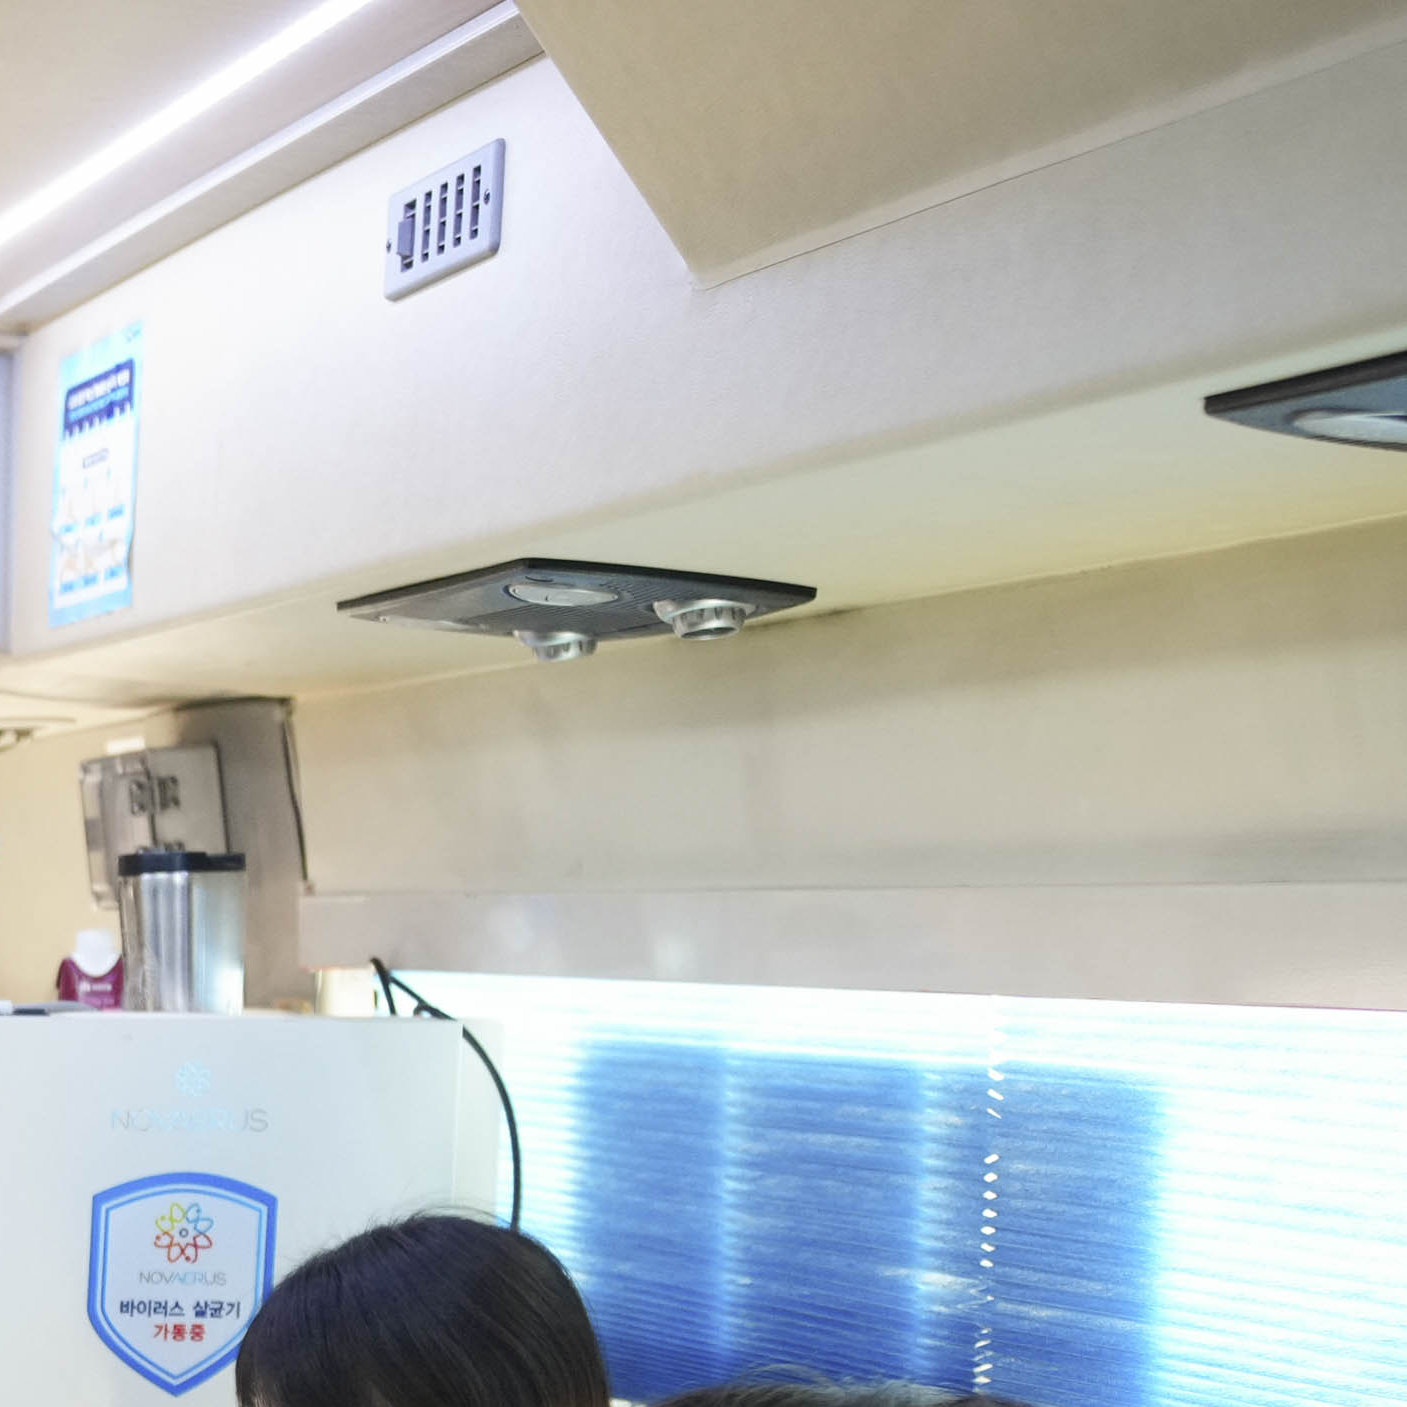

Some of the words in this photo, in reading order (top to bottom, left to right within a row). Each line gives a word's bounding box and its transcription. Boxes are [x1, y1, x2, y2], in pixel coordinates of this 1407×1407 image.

[139, 1271, 227, 1286] NOVAERUS
[119, 1300, 185, 1319] 바이러스
[192, 1300, 241, 1319] 살균기
[153, 1323, 206, 1342] 가동중
